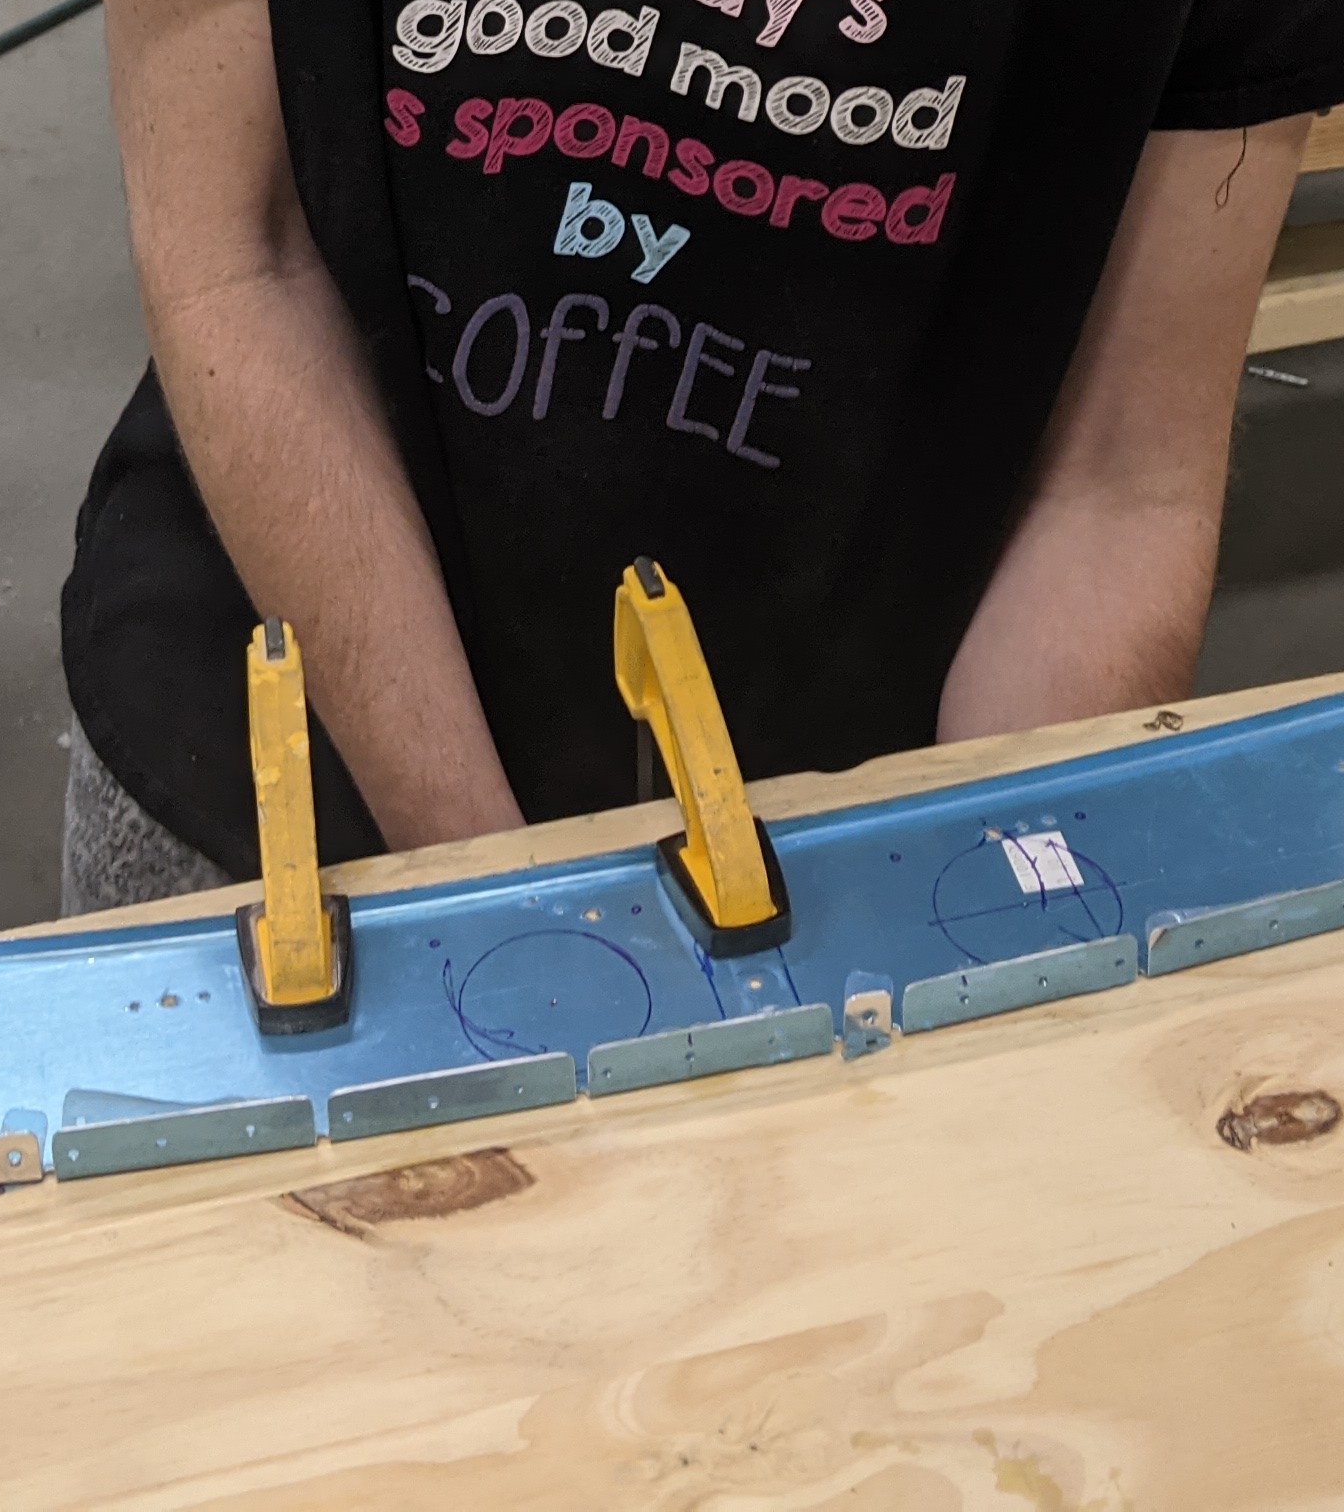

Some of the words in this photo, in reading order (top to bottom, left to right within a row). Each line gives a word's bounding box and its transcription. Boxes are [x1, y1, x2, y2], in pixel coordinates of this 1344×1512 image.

[669, 41, 967, 151] mood
[445, 97, 957, 245] sponsored
[553, 181, 692, 285] by
